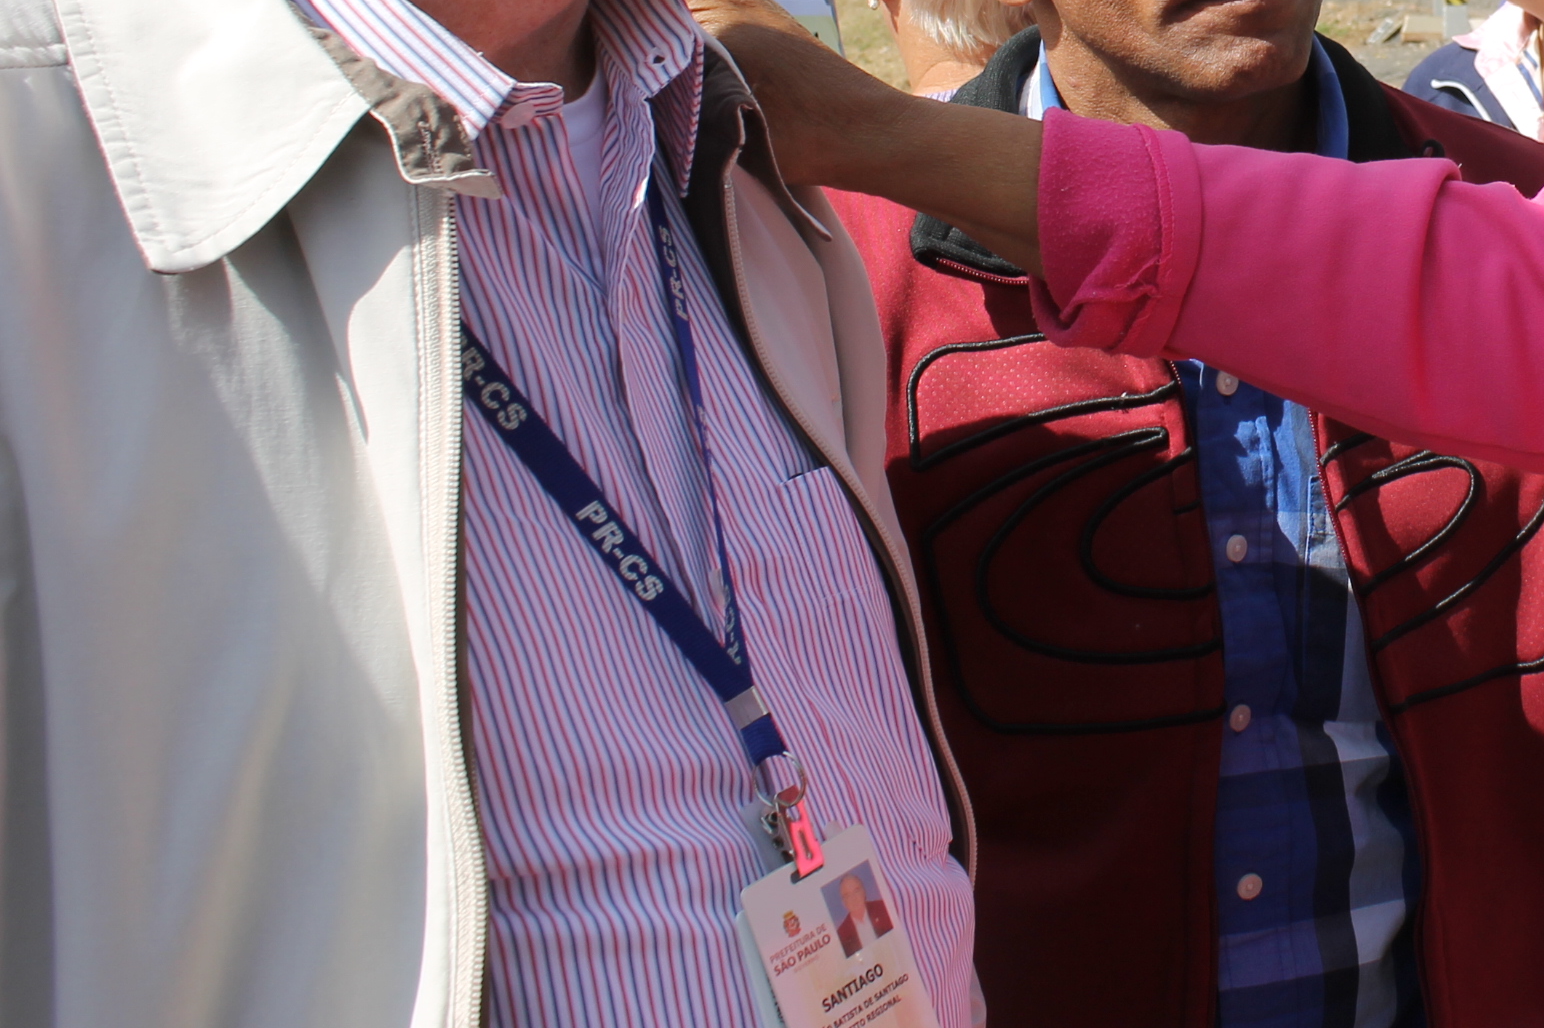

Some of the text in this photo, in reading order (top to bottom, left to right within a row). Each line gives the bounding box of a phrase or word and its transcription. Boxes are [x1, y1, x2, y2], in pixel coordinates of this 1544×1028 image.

[658, 224, 689, 321] PR-CS
[575, 500, 664, 601] PR-CS
[770, 931, 815, 964] PREFEITURA
[816, 923, 827, 935] DE
[797, 934, 831, 961] PAULO
[822, 963, 883, 1013] SANTIAGO
[833, 1004, 863, 1028] BATISTA
[863, 997, 875, 1009] DE
[874, 973, 909, 1002] SANTIAGO
[866, 995, 902, 1022] REGIONAL
